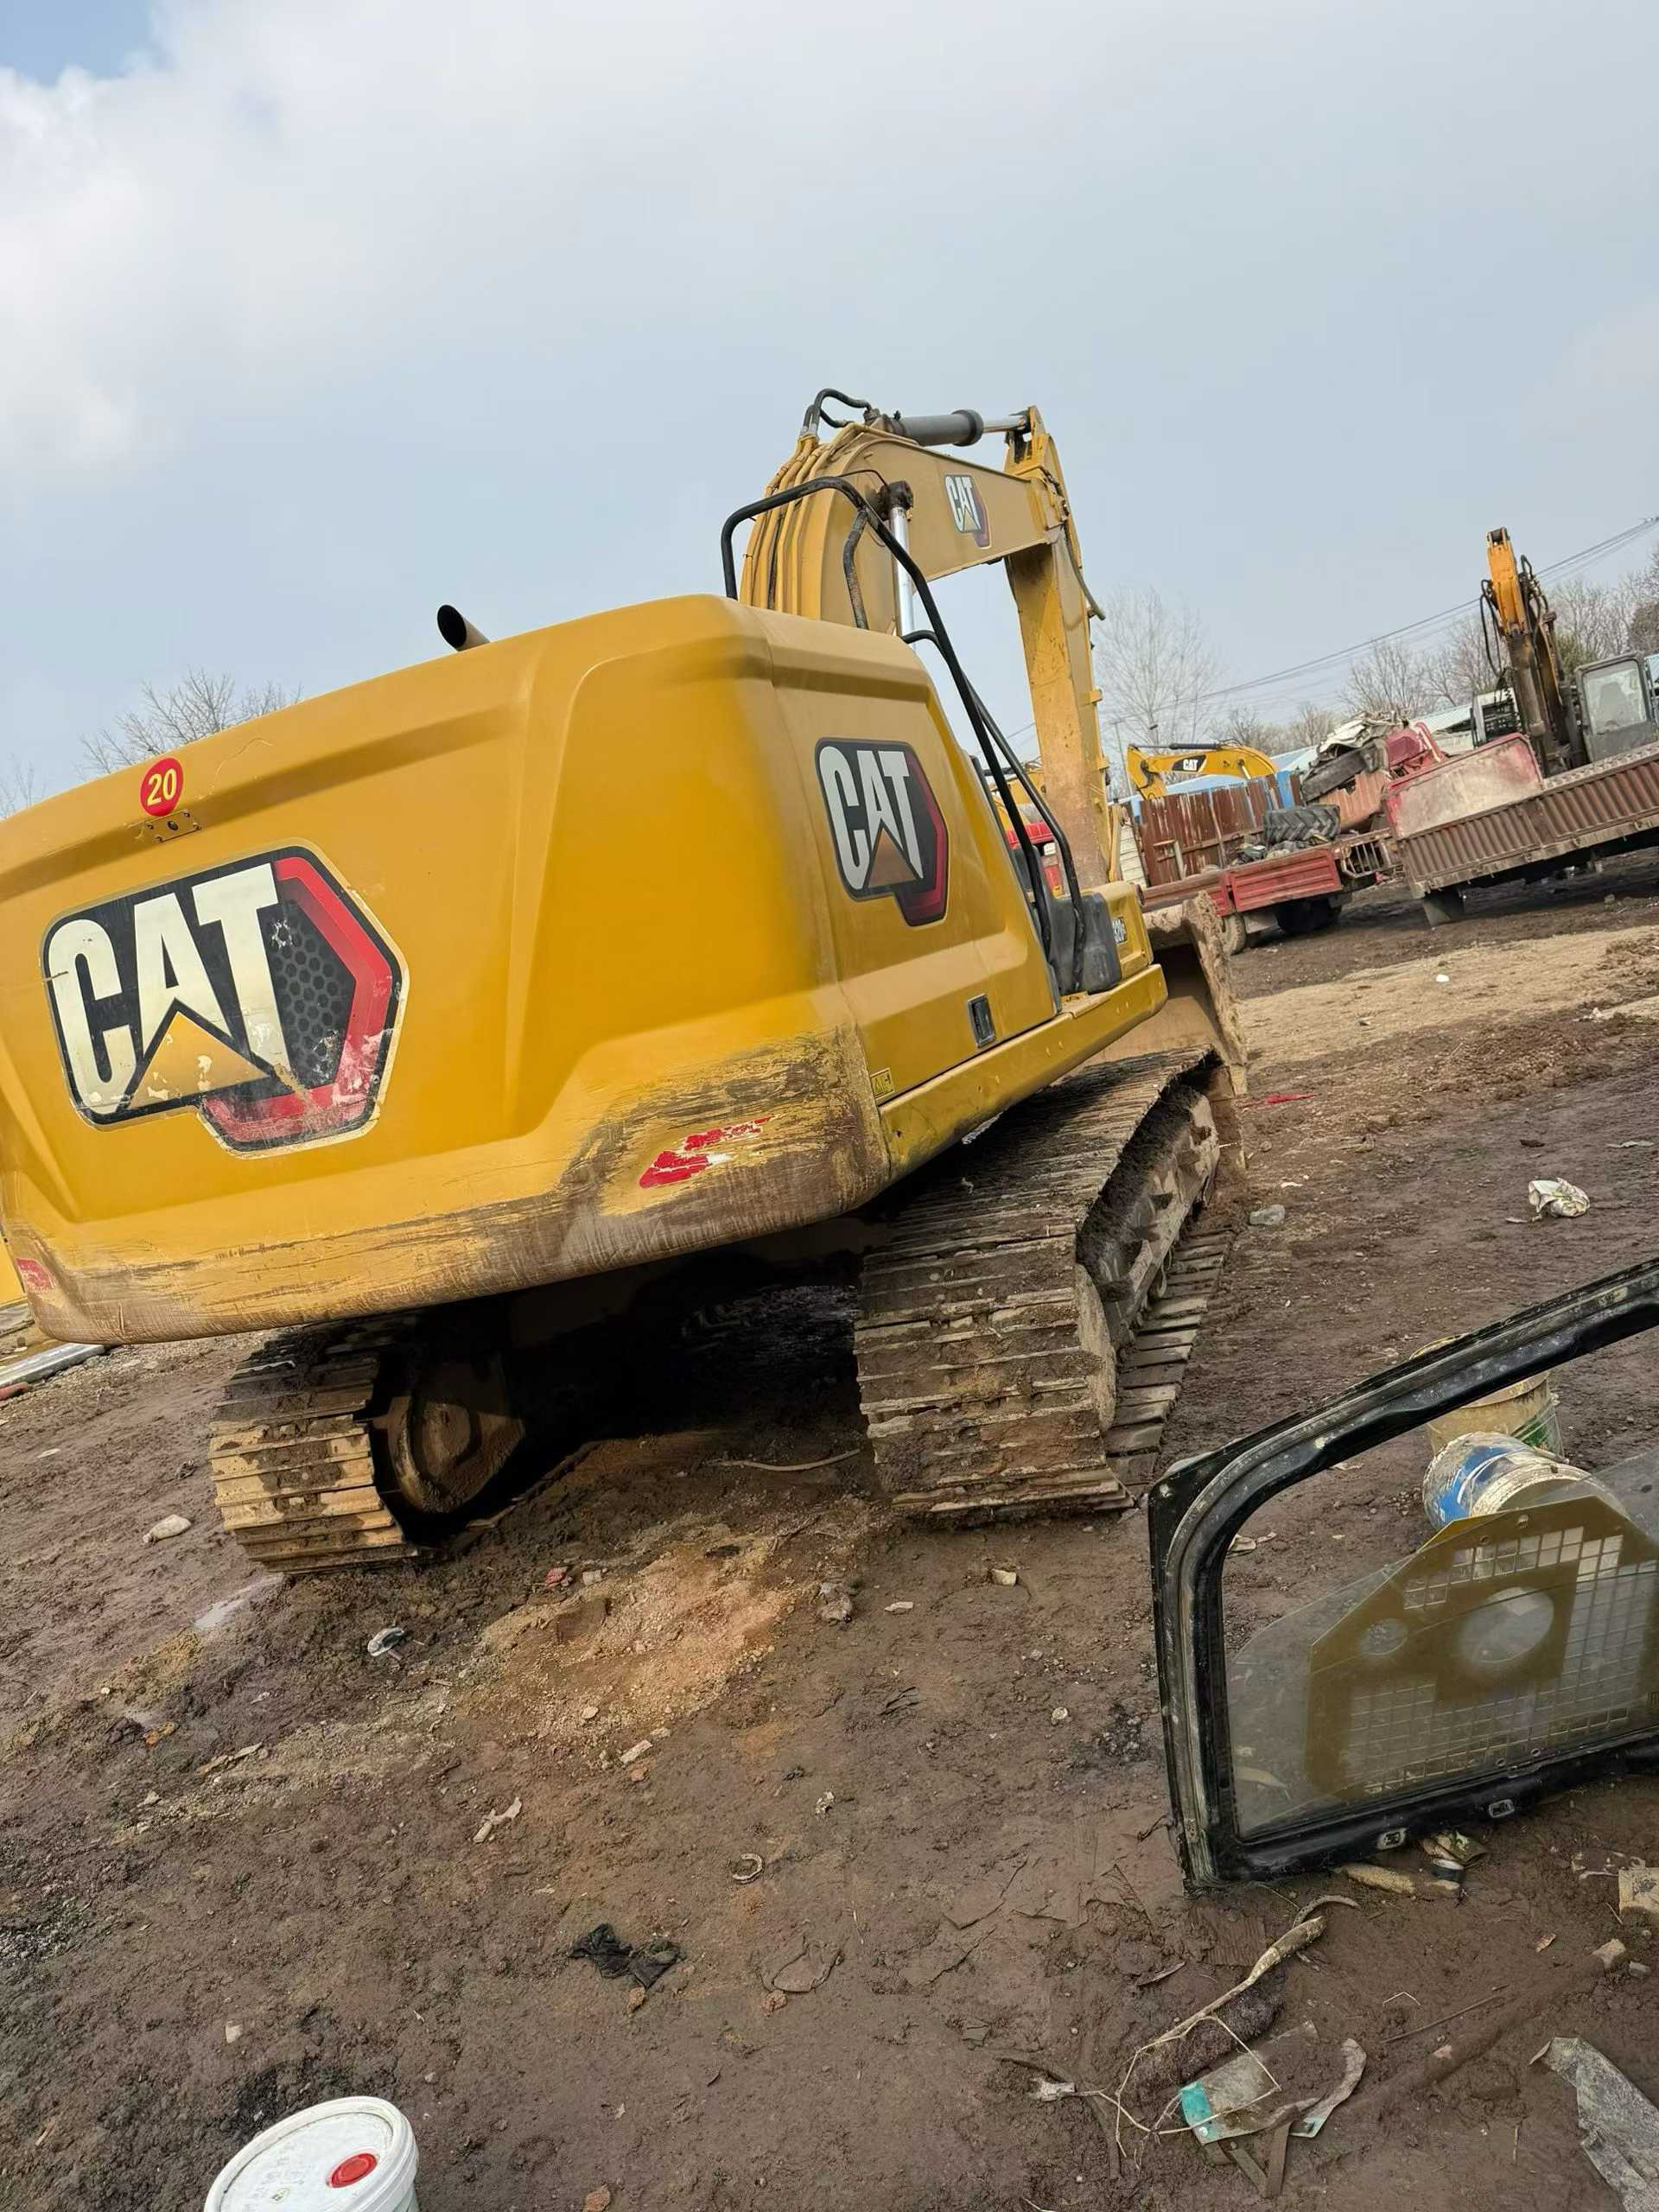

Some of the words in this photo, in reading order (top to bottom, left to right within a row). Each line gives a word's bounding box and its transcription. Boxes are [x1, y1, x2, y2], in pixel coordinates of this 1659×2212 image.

[945, 476, 982, 532] CAT
[147, 768, 177, 806] 20
[1183, 759, 1198, 771] CAT
[819, 746, 924, 890] CAT
[48, 862, 290, 1115] CAT
